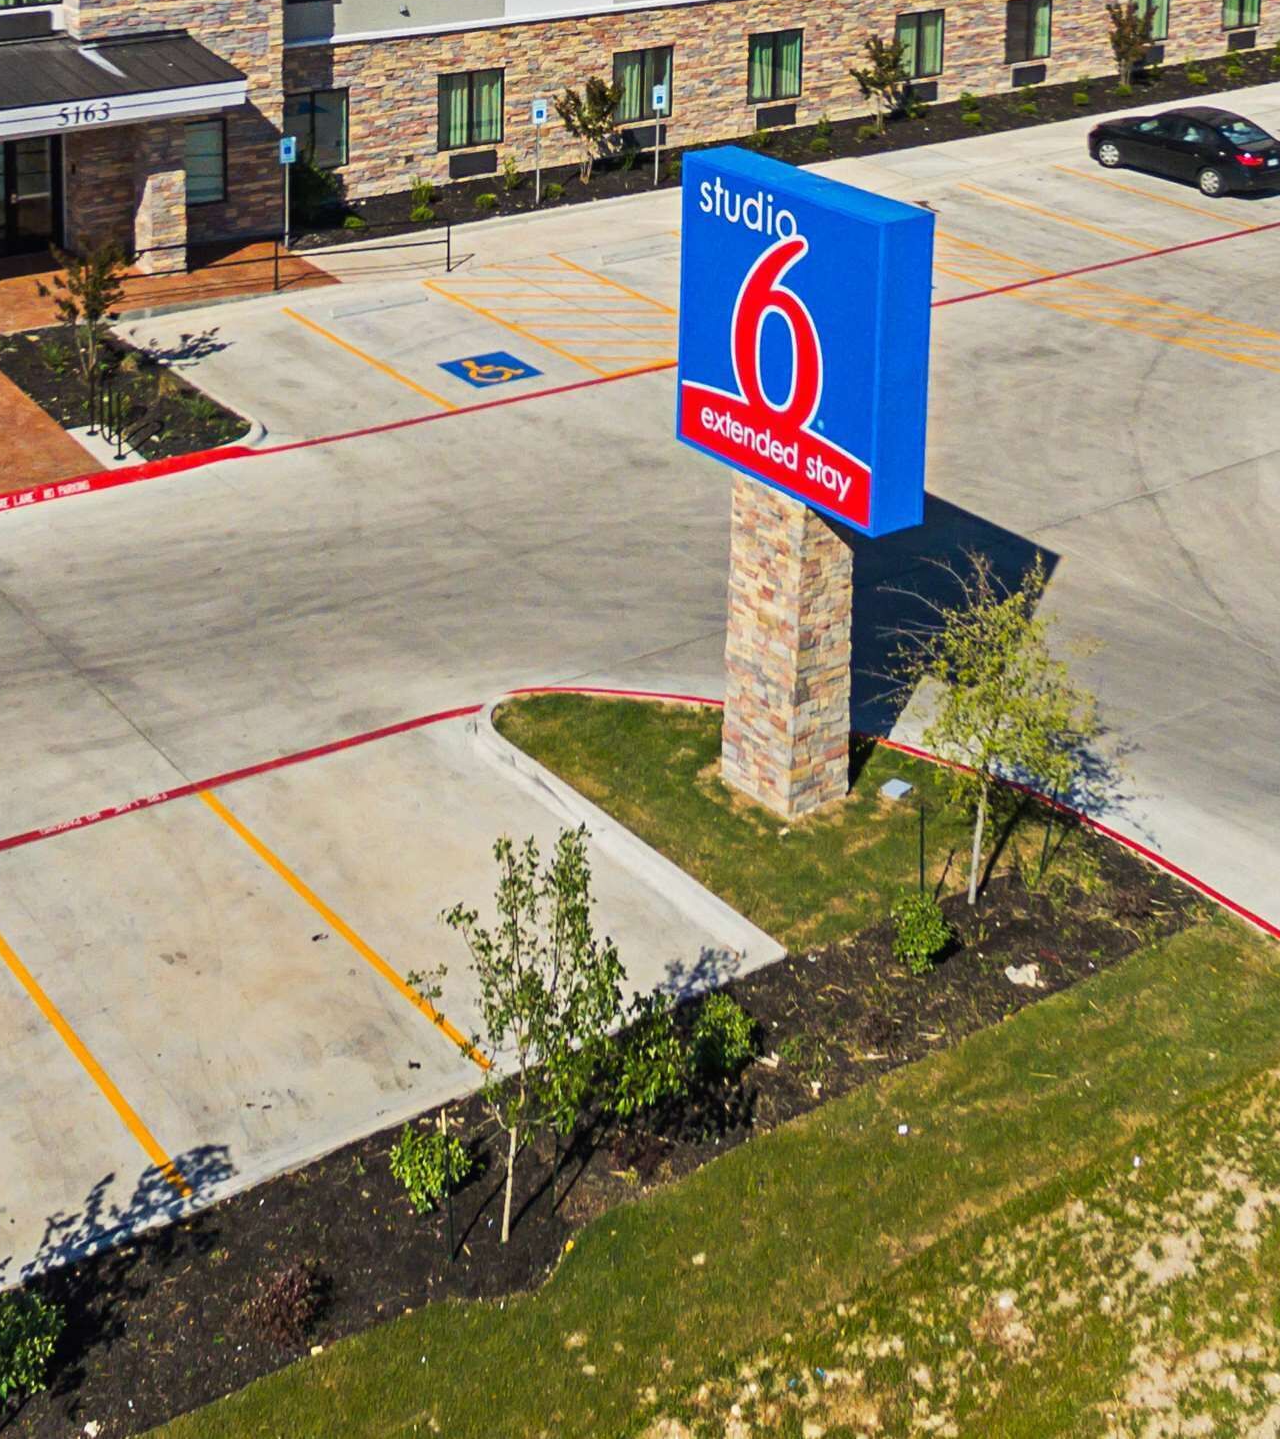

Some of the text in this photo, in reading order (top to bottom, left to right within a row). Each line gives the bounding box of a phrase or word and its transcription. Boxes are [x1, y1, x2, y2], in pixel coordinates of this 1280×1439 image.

[57, 102, 110, 126] 5163
[699, 176, 798, 241] studio
[731, 234, 823, 429] 6
[700, 405, 852, 503] extended stay
